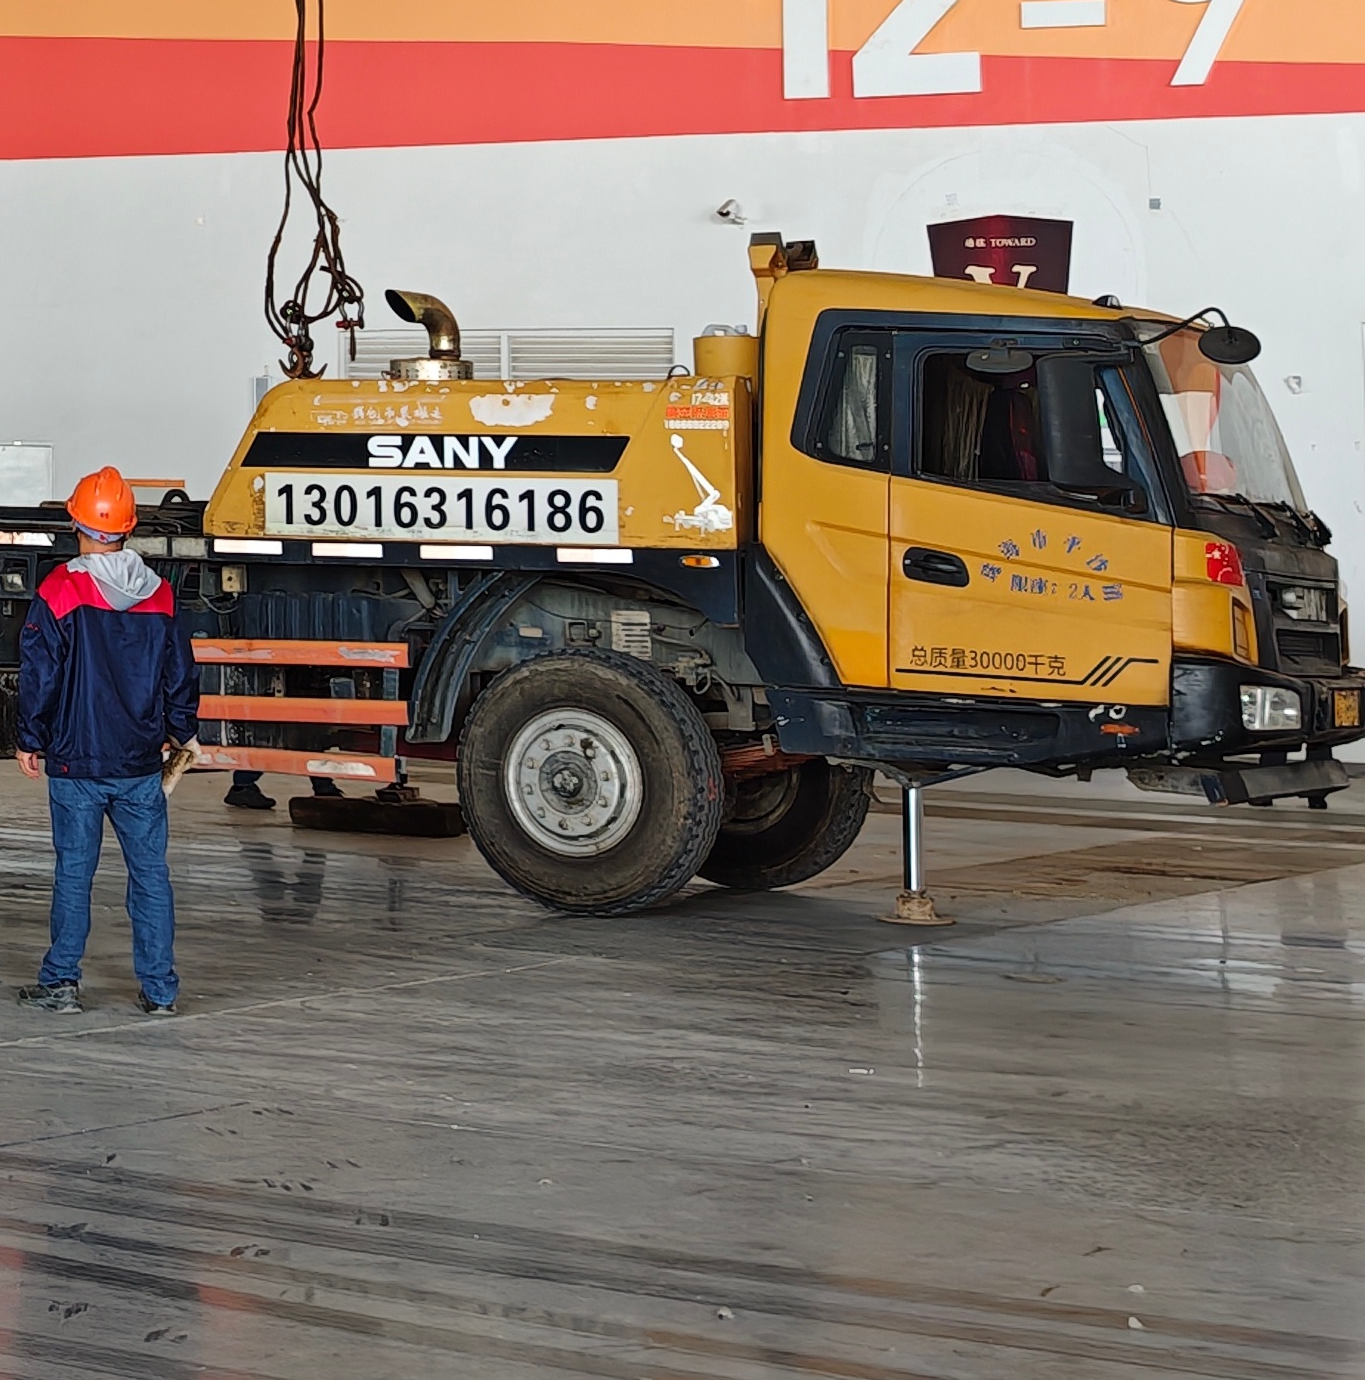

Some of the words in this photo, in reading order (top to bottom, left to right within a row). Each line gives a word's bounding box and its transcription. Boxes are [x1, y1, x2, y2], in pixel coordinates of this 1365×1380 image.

[989, 237, 1036, 248] TOWARD
[367, 436, 519, 470] SANY
[277, 483, 605, 534] 13016316186
[910, 645, 1066, 677] 总质量30000千克
